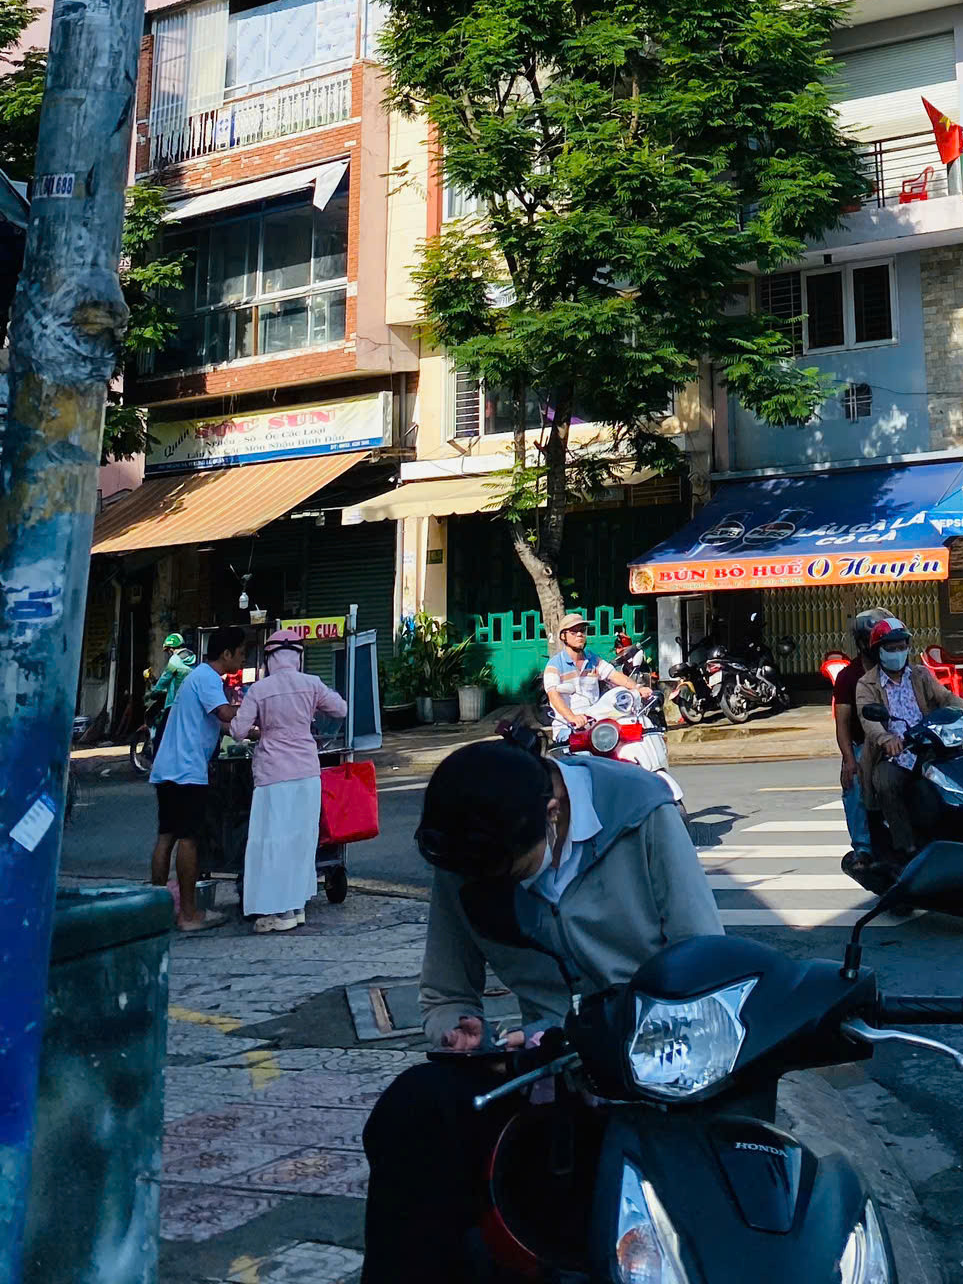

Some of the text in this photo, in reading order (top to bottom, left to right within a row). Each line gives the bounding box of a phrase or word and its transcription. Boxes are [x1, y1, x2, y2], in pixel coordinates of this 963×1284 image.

[659, 553, 940, 582] BÚN BÒ HUẾ O Huyền
[316, 623, 338, 639] CUA
[735, 1142, 788, 1158] HONDA
